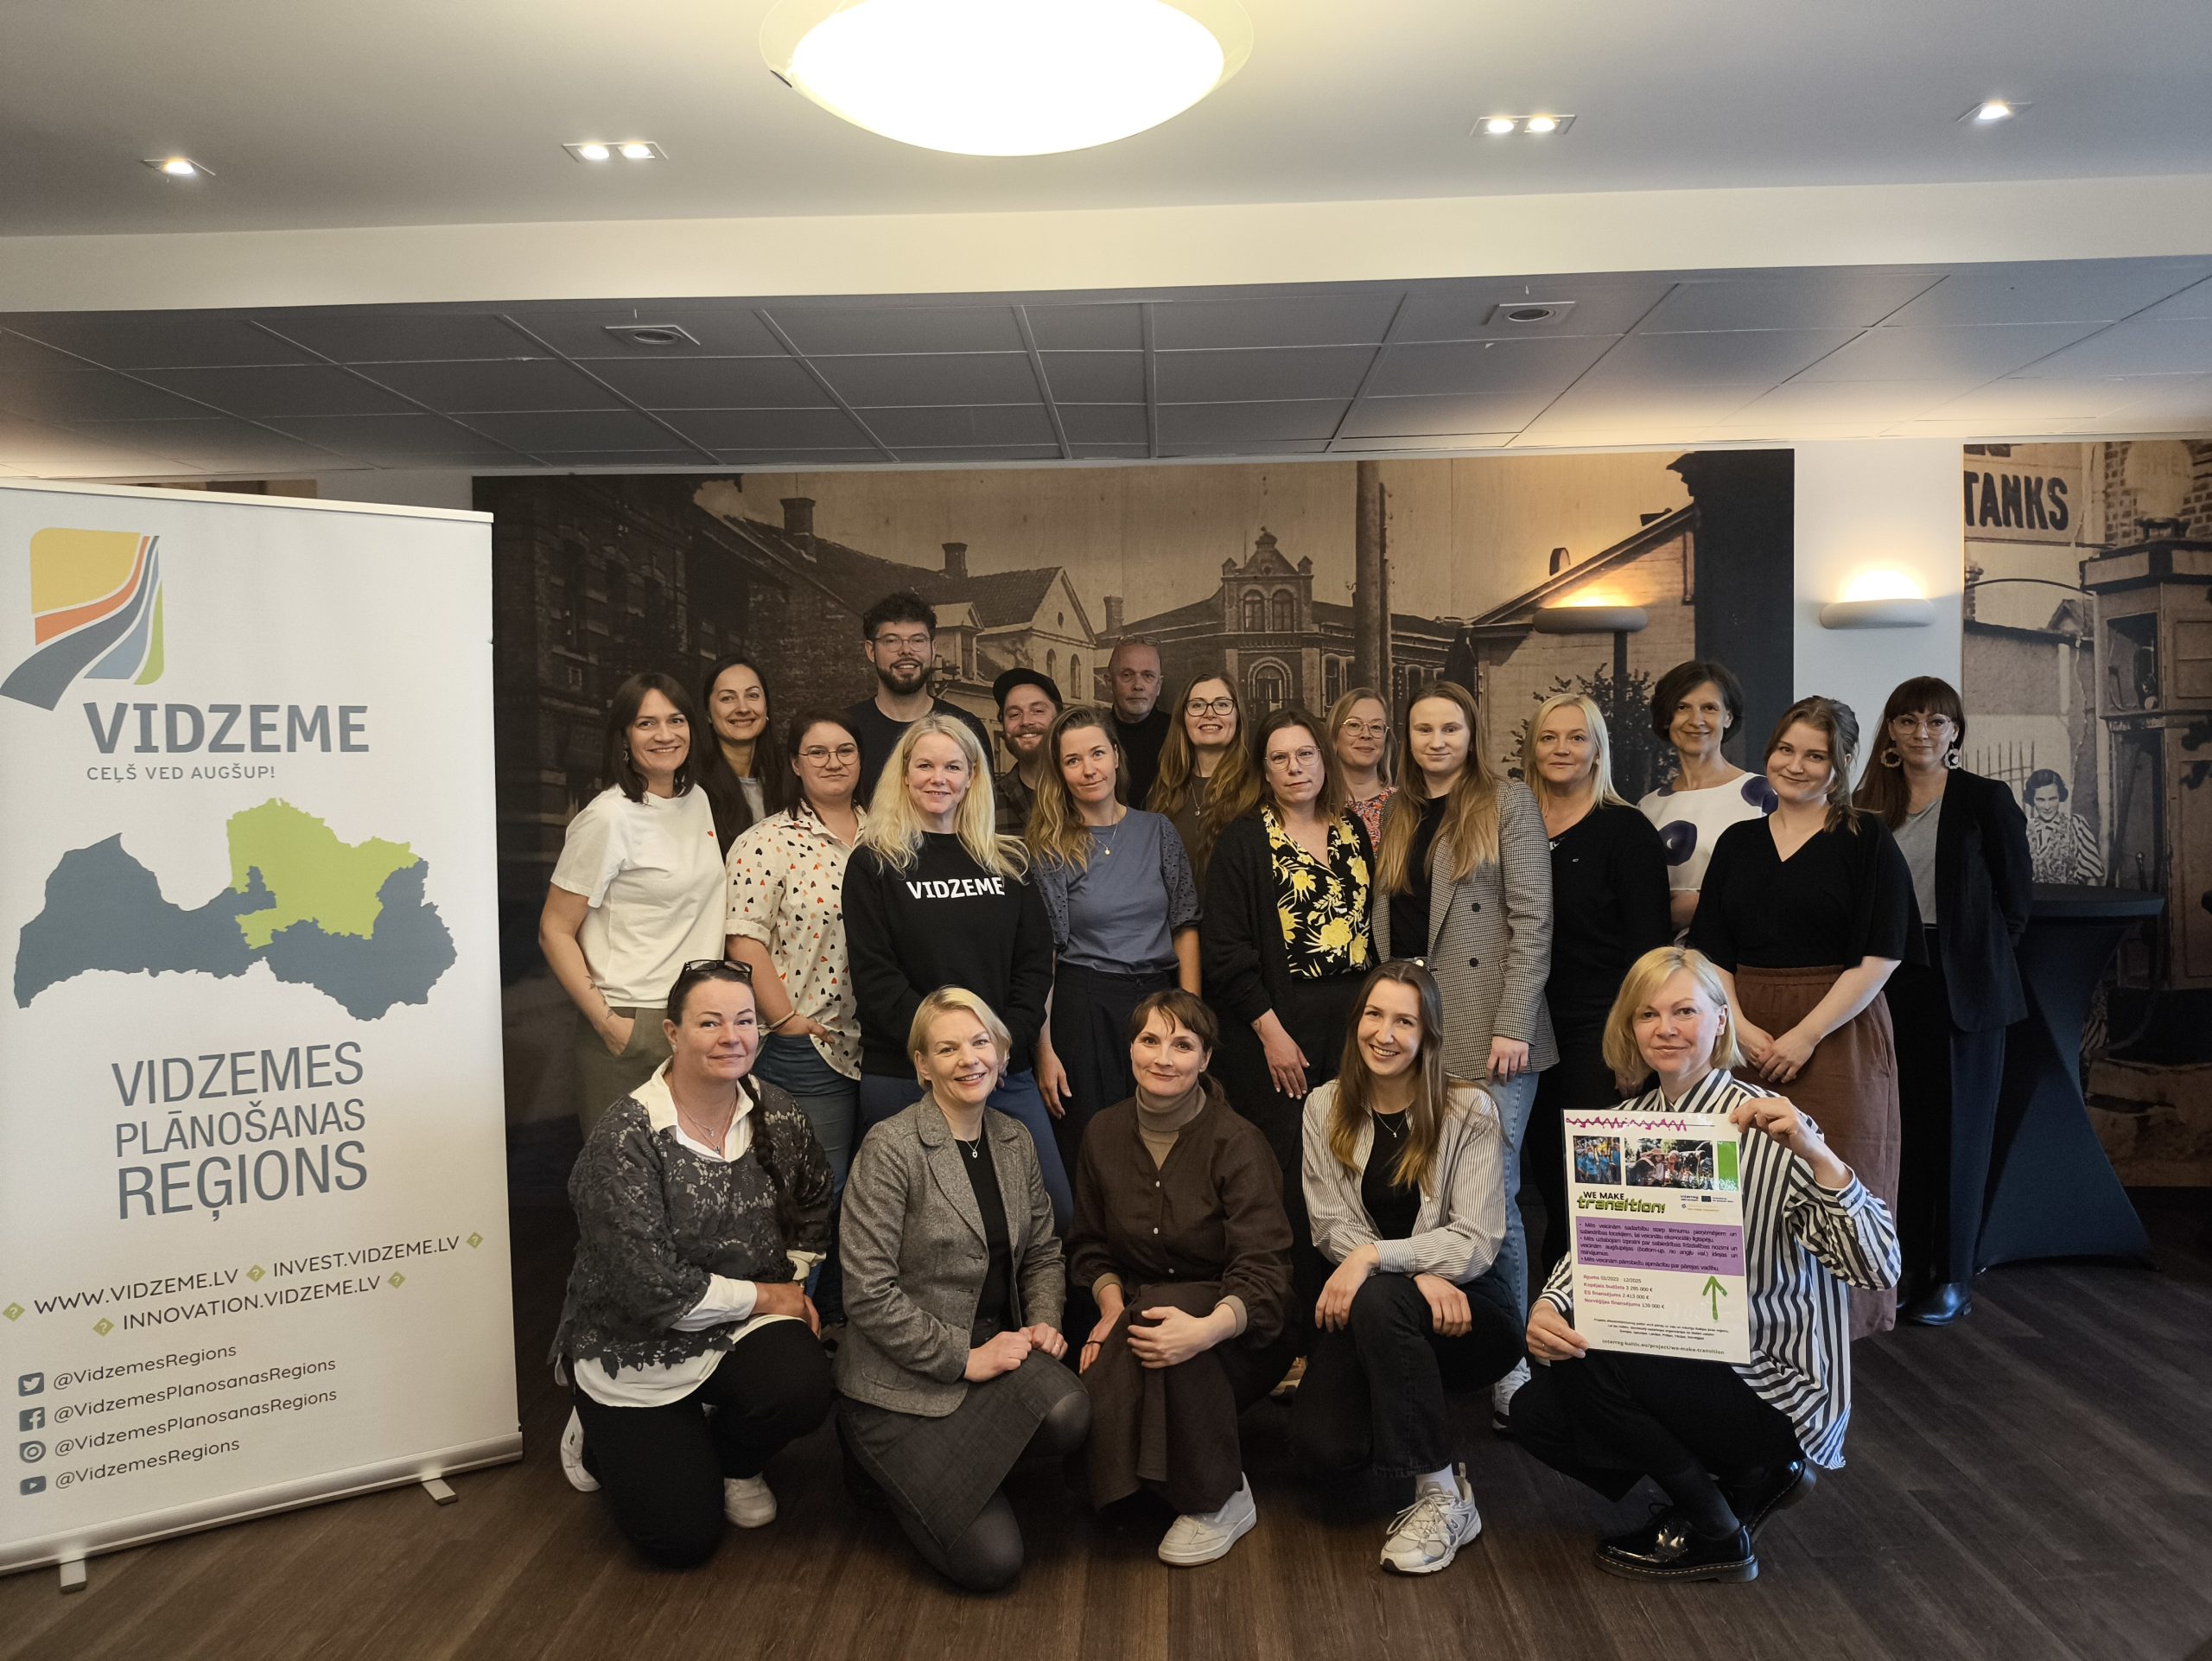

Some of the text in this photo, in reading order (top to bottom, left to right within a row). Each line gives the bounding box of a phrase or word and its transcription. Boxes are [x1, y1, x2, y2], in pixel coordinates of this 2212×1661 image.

[83, 703, 370, 754] VIDZEME
[87, 763, 276, 782] CEĻŠ VED AUGŠUP!
[906, 877, 1005, 899] VIDZEME
[111, 1041, 363, 1107] VIDZEMES
[116, 1098, 365, 1157] PLĀNOŠANAS
[119, 1140, 367, 1221] REĢIONS
[1577, 1195, 1665, 1213] transition!
[34, 1269, 238, 1315] WWW.VIDZEME.LV
[273, 1236, 460, 1277] INVEST.VIDZEME.LV
[124, 1276, 381, 1331] INNOVATION.VIDZEME.LV
[54, 1346, 237, 1391] @VidzemesRegions
[54, 1359, 336, 1425] @VidzemesPlanosanasRegions
[55, 1390, 337, 1457] @VidzemesPlanosanasRegions
[55, 1440, 239, 1490] @VidzemesRegions
